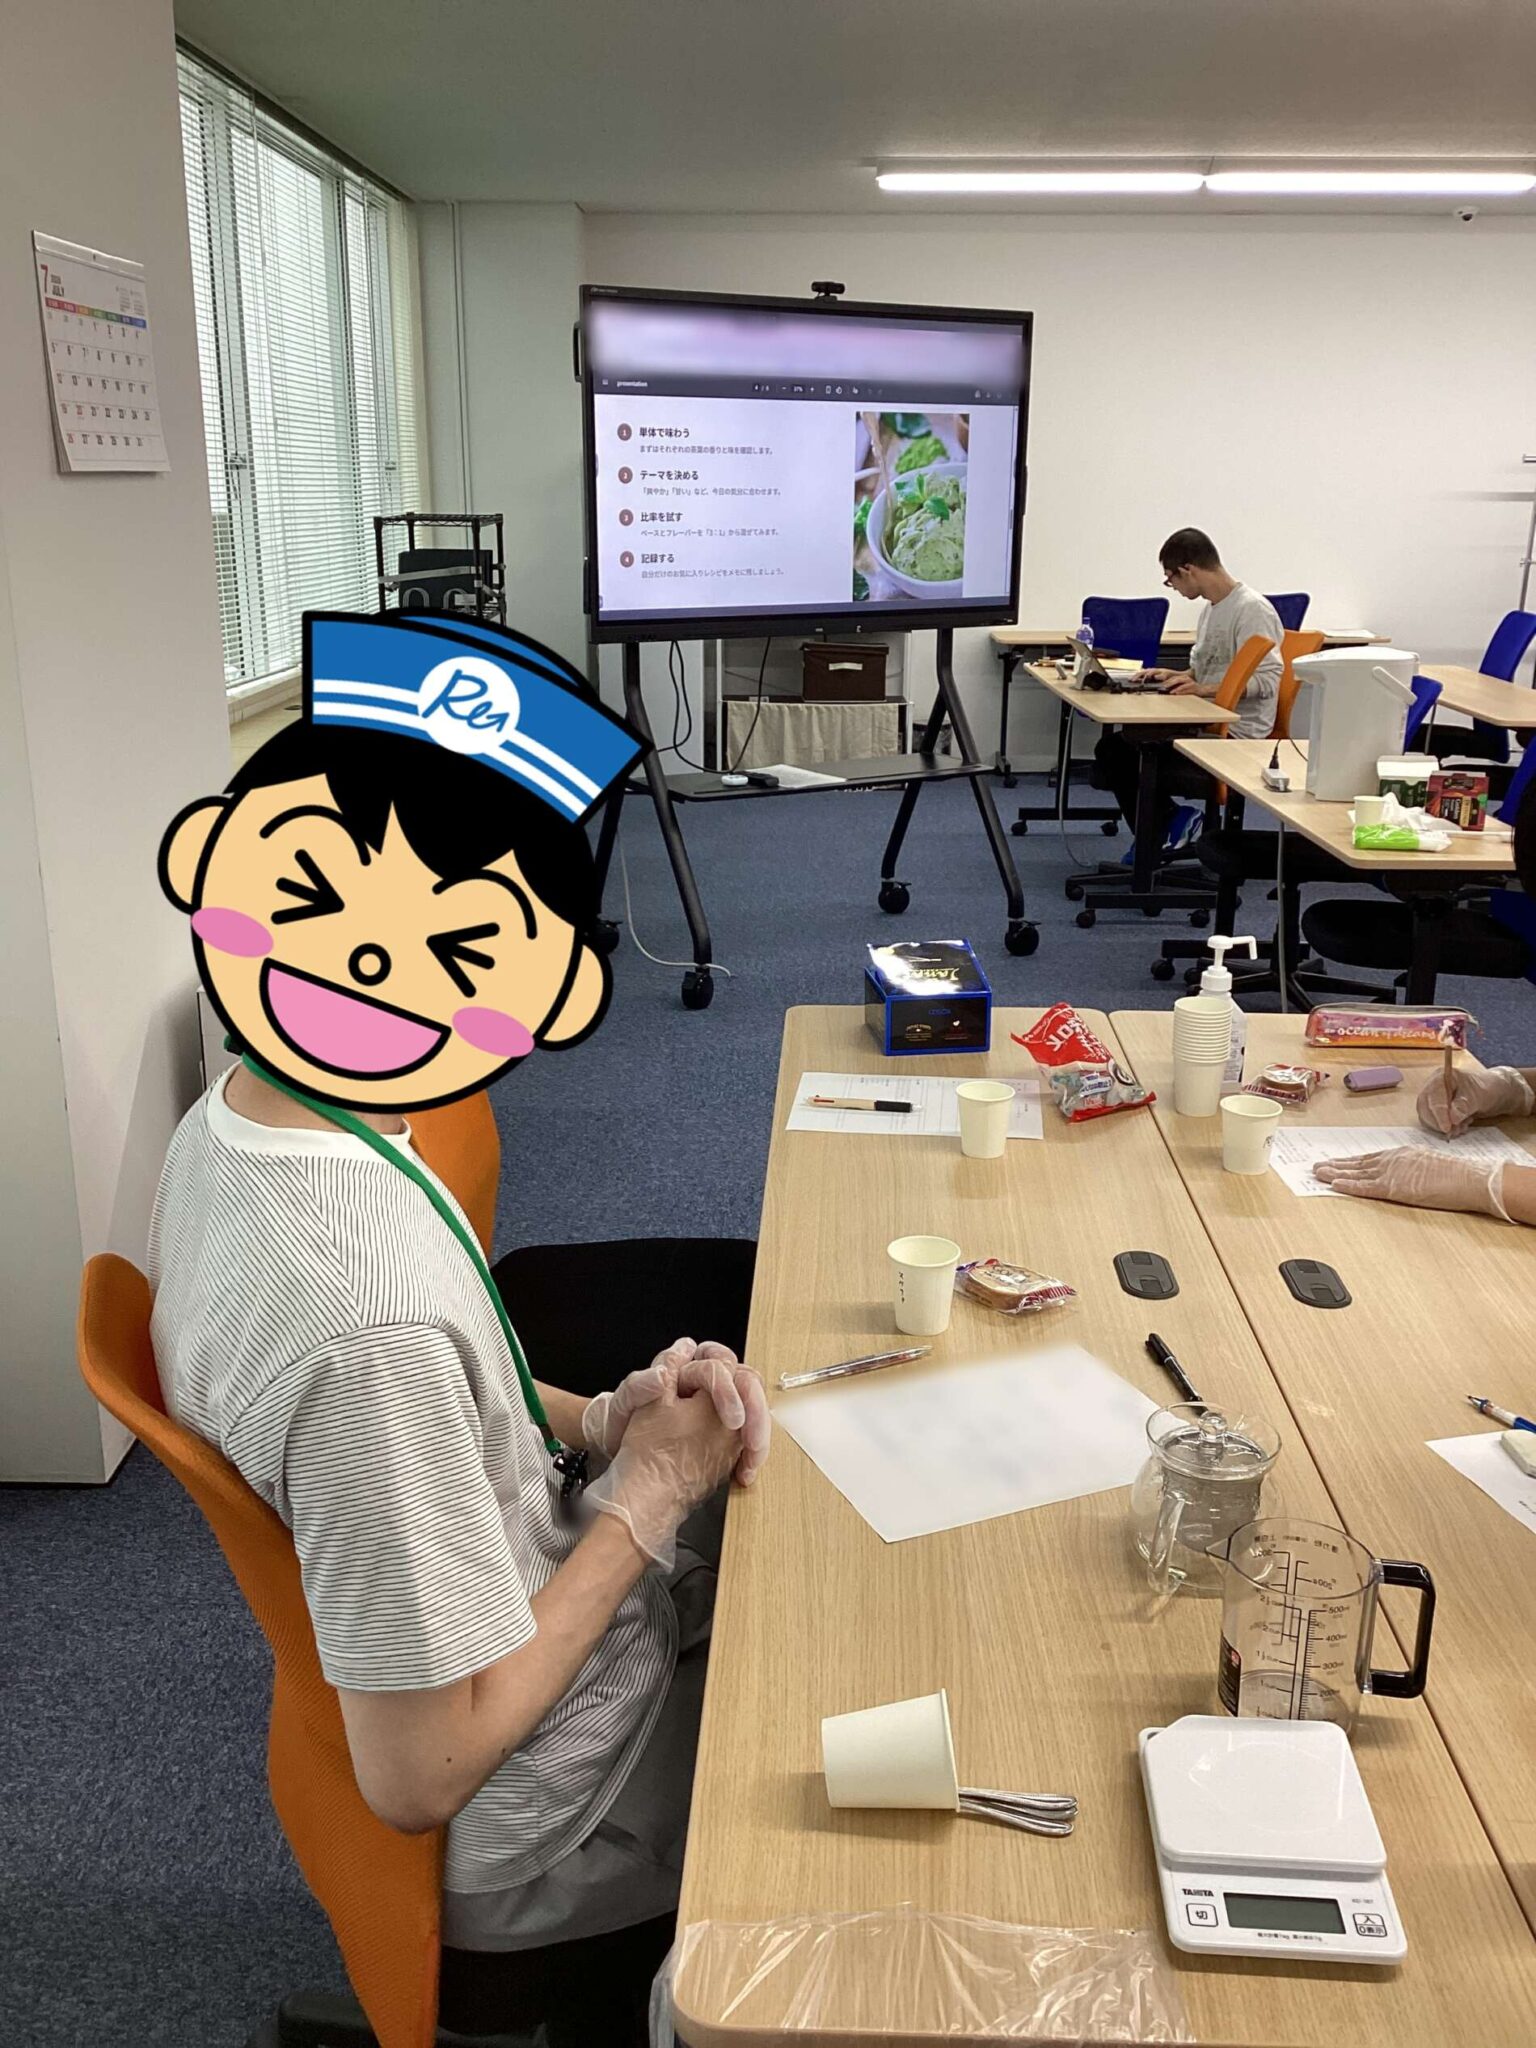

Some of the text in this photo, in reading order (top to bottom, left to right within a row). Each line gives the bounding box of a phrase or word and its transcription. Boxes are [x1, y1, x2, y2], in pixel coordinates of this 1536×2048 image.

[41, 264, 48, 294] 7
[639, 427, 690, 438] 単体で味わう
[640, 470, 699, 480] テーマを決める
[640, 512, 683, 522] 比率を試す
[641, 553, 675, 563] 記録する
[1182, 1888, 1214, 1896] TANITA
[1195, 1910, 1208, 1920] 切
[1363, 1915, 1376, 1924] 入
